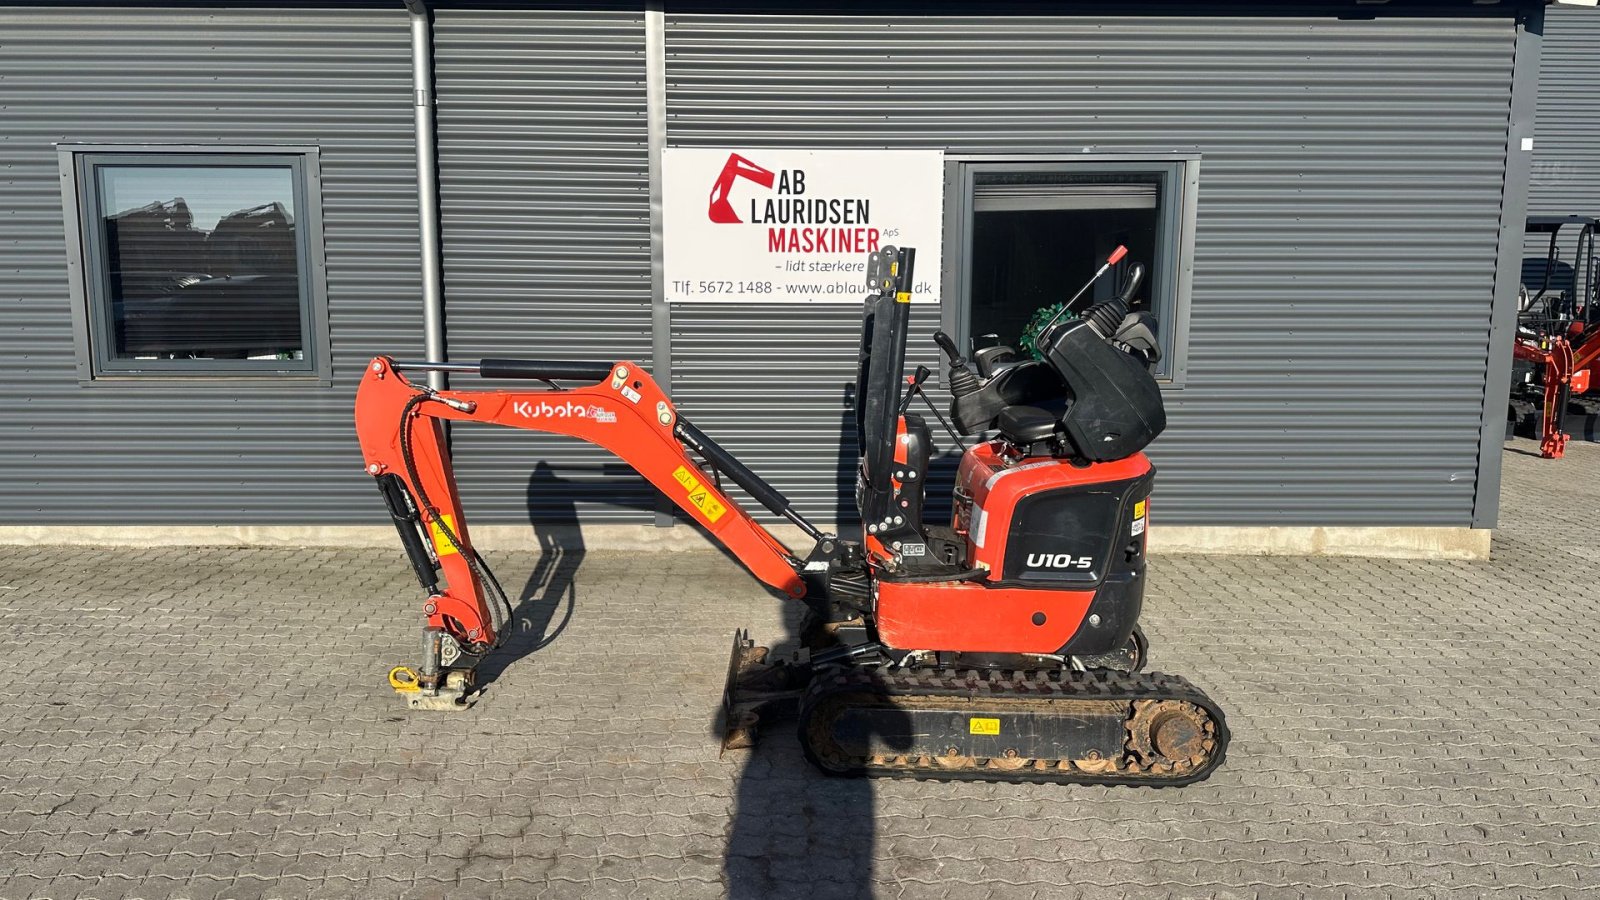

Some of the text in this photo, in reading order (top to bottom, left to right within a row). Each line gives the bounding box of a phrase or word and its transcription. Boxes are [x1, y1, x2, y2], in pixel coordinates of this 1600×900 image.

[778, 170, 805, 195] AB
[751, 198, 870, 224] LAURIDSEN
[768, 227, 900, 253] MASKINER ApS
[785, 260, 806, 272] lidt
[808, 260, 865, 272] stærkere
[672, 280, 694, 295] Tlf.
[699, 280, 734, 294] 5672
[738, 280, 773, 294] 1488
[513, 401, 586, 419] Kubota
[1026, 553, 1093, 569] U10-5
